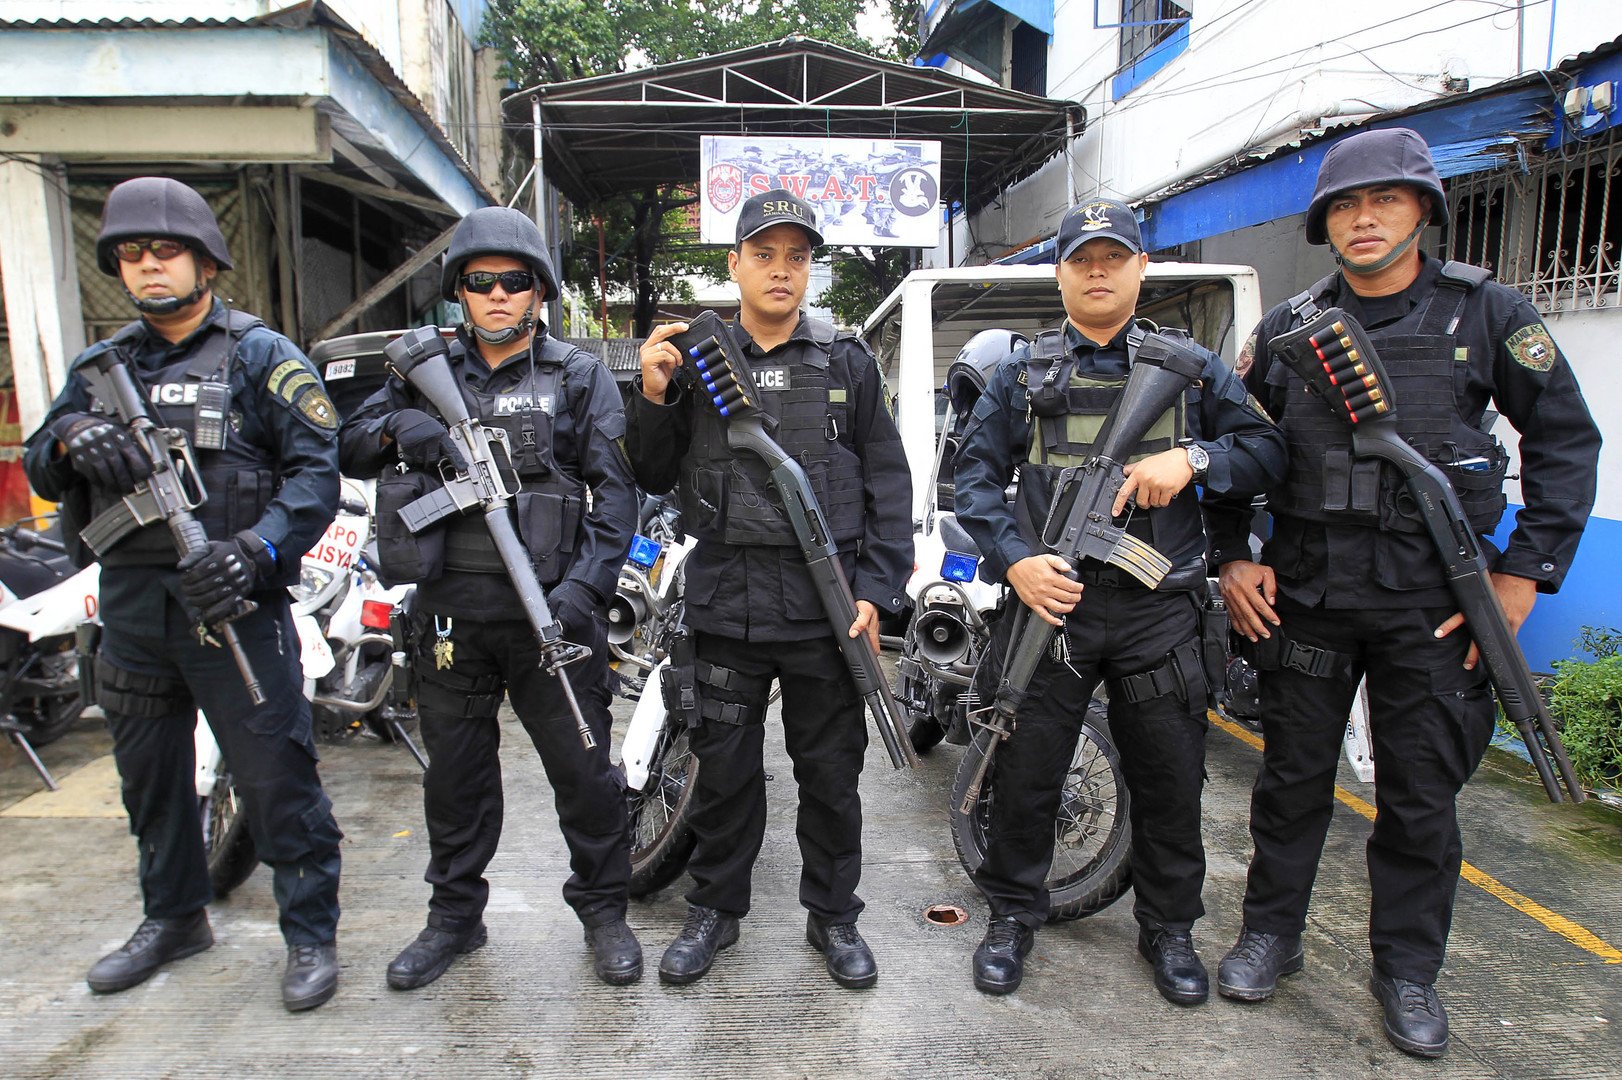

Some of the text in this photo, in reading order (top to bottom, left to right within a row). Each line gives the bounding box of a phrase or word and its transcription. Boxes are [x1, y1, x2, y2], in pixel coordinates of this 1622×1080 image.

[750, 174, 884, 201] SW.A.T.
[763, 201, 804, 217] SRU
[752, 370, 784, 388] LICE
[150, 383, 200, 404] ICE
[498, 396, 550, 413] POLIE
